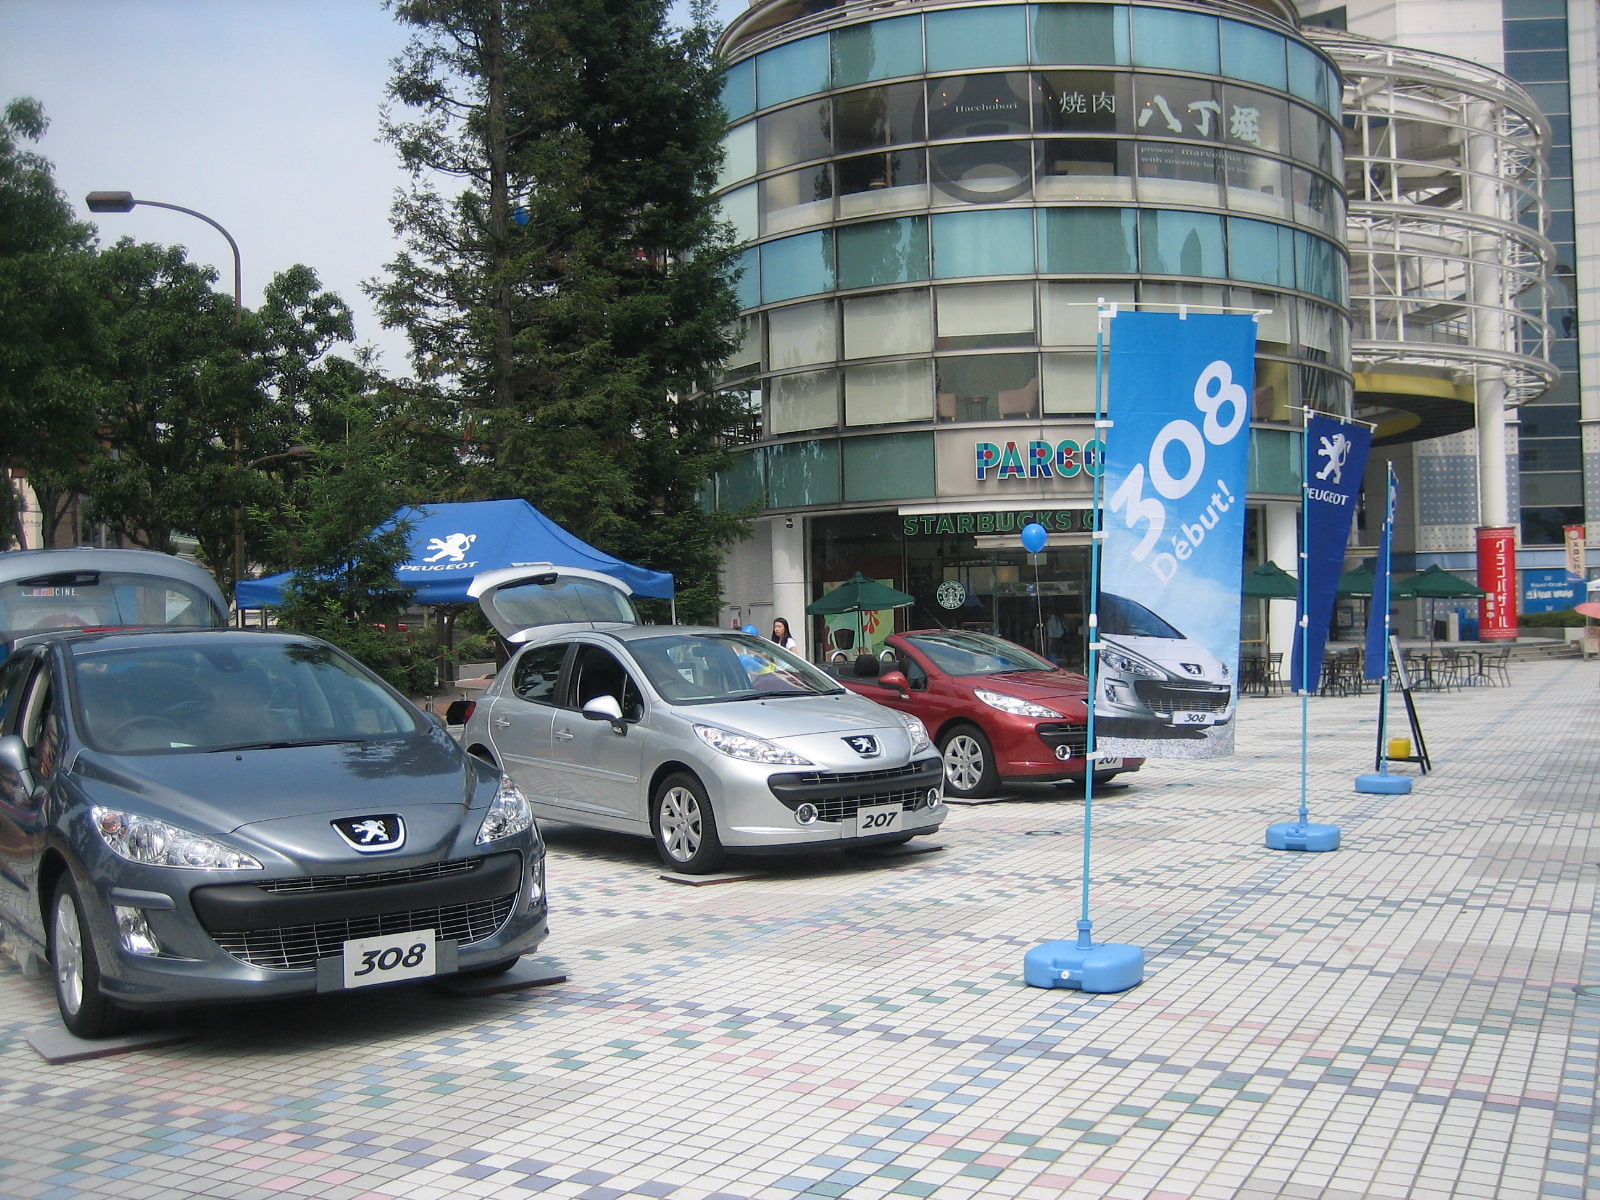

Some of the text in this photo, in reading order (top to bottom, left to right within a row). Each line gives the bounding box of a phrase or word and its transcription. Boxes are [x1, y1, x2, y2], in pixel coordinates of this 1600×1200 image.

[955, 101, 1018, 113] Hacchobori
[1059, 91, 1262, 146] 焼肉 八丁堀
[1165, 158, 1201, 168] sincerity
[974, 438, 1107, 482] PARCO
[1109, 359, 1248, 563] 308
[903, 510, 1072, 536] STARBUCKS
[1150, 478, 1236, 586] Début!
[398, 560, 480, 572] PEUGEOT
[1184, 713, 1207, 723] 308
[862, 811, 898, 829] 207
[354, 942, 427, 977] 308
